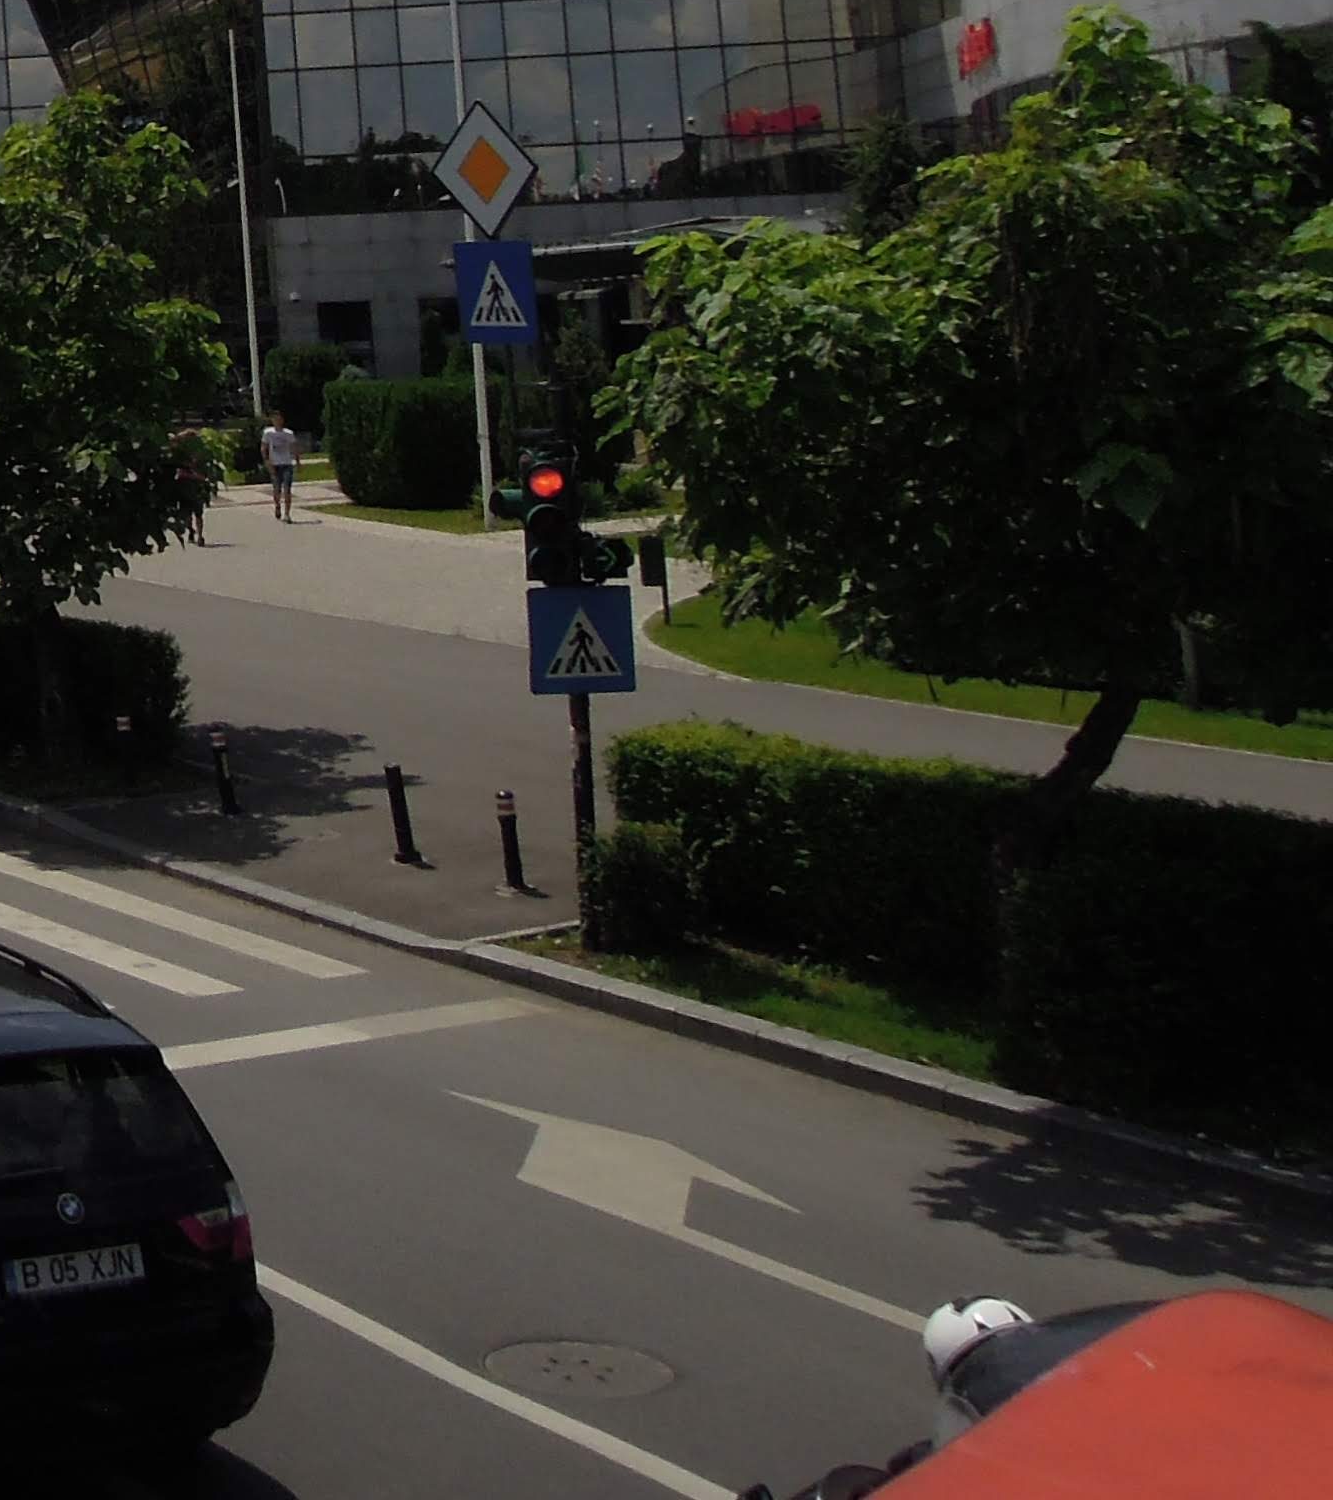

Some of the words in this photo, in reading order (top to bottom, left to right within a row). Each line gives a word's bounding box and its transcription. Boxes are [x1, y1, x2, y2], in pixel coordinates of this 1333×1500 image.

[21, 1260, 40, 1289] B
[49, 1255, 79, 1284] 05
[88, 1248, 134, 1280] XJN
